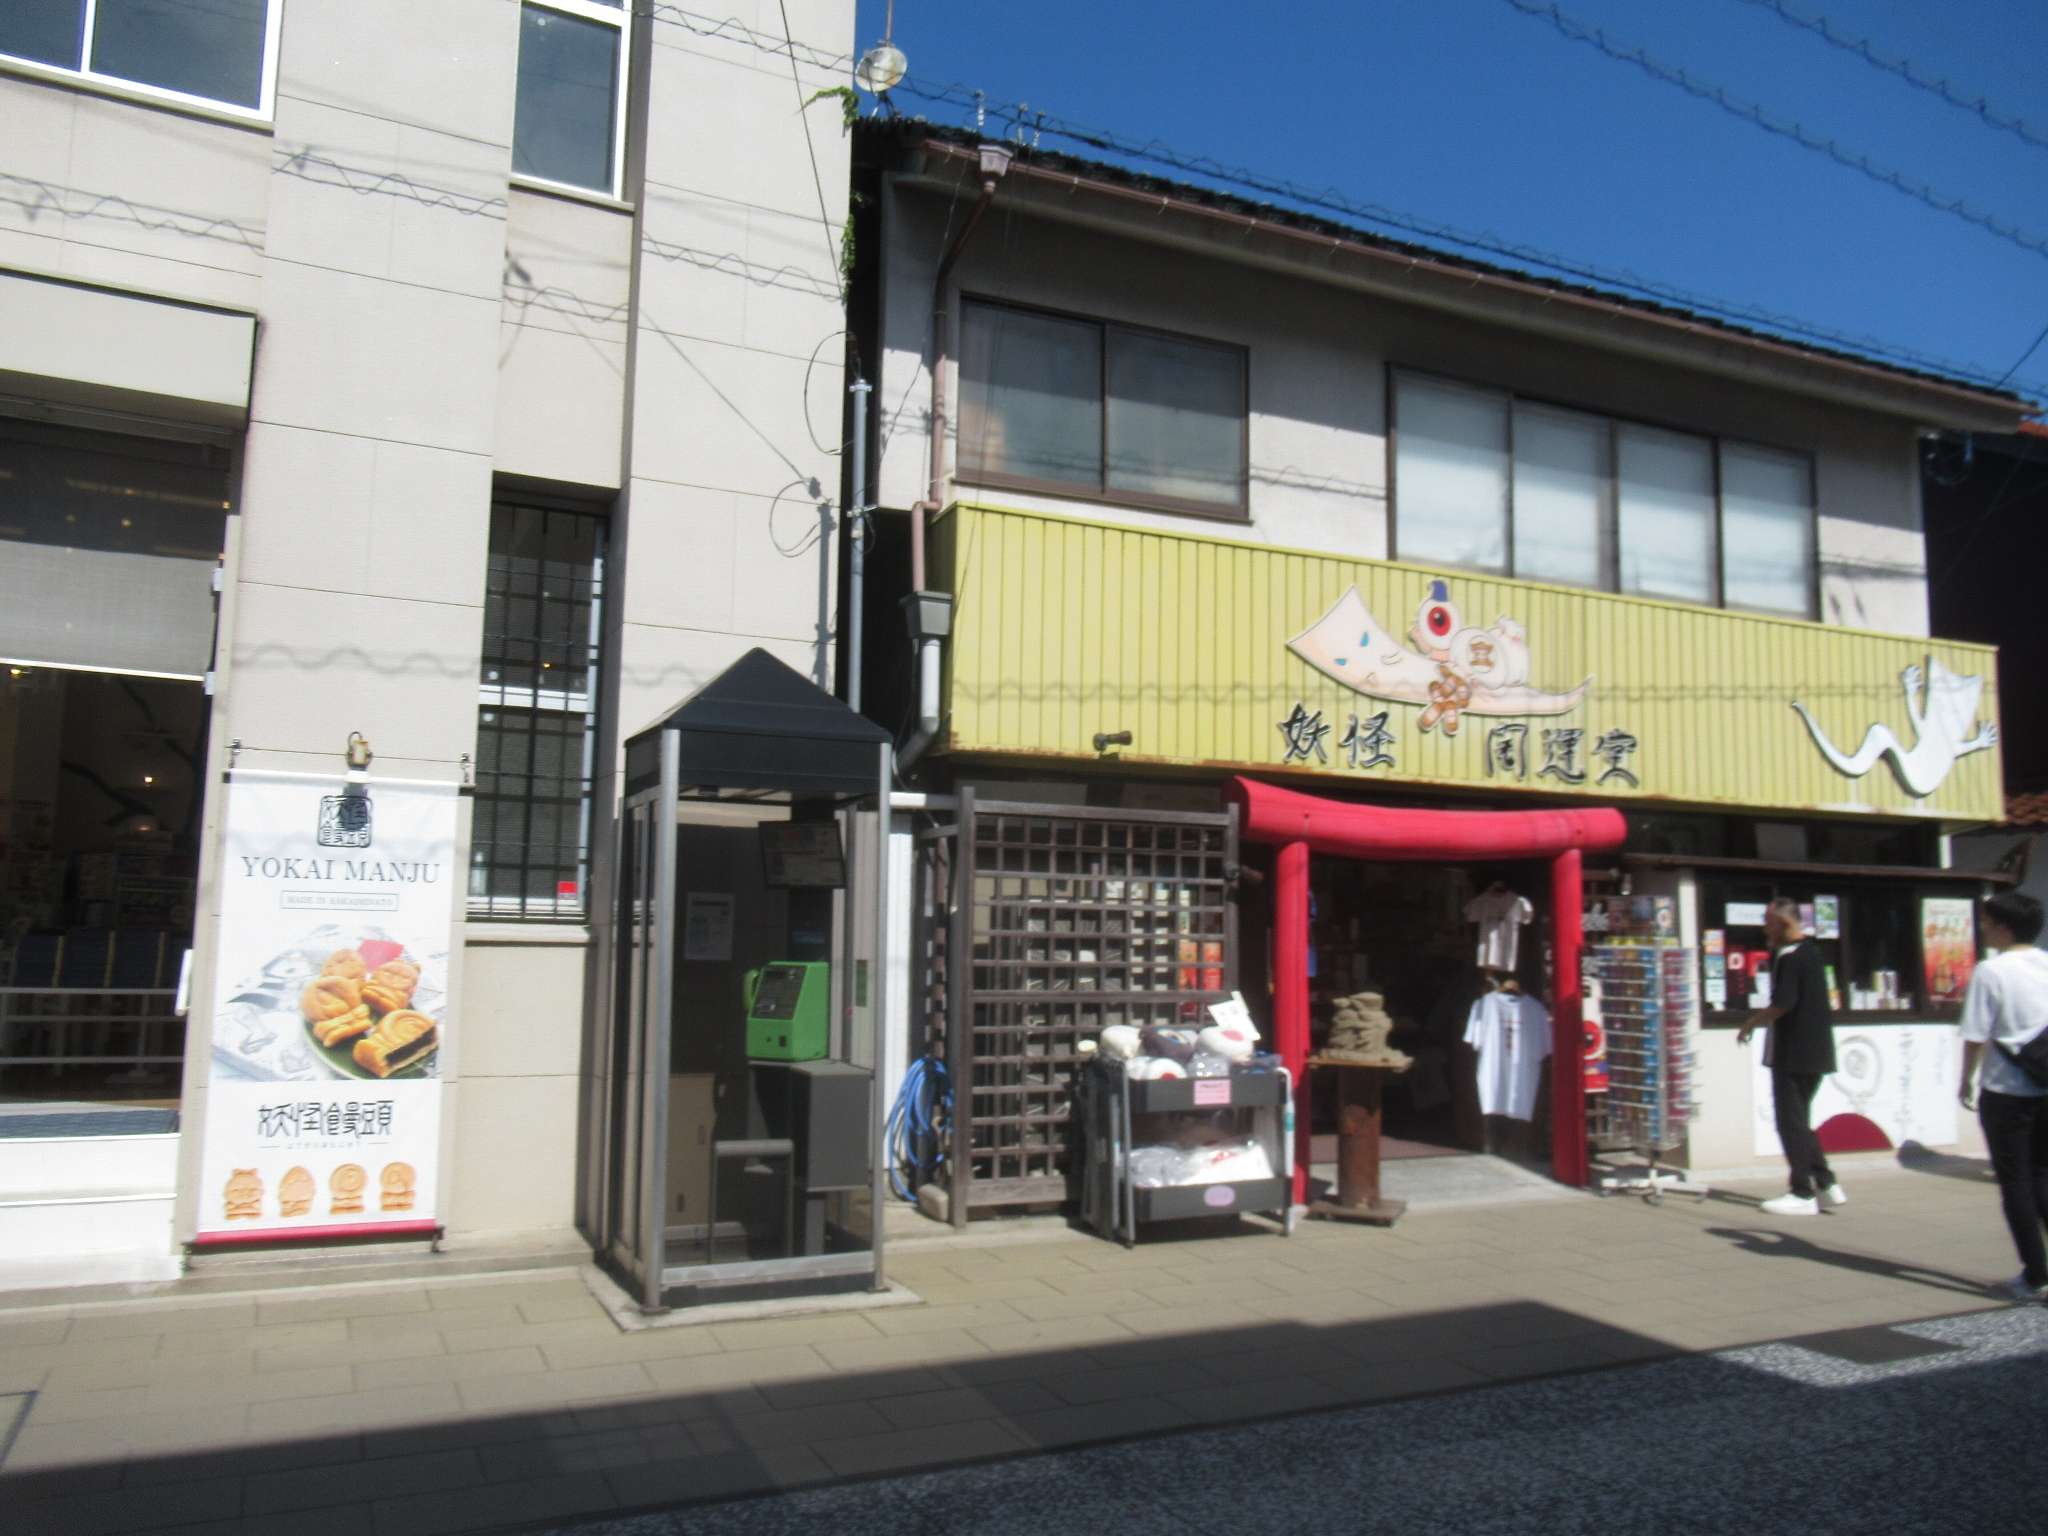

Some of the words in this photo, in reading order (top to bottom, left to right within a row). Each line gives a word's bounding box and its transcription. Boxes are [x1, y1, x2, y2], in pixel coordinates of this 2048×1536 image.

[1277, 703, 1396, 771] 妖怪
[240, 856, 337, 881] YOKAI
[344, 860, 441, 884] MANJU
[257, 1100, 395, 1138] 妖怪饅頭
